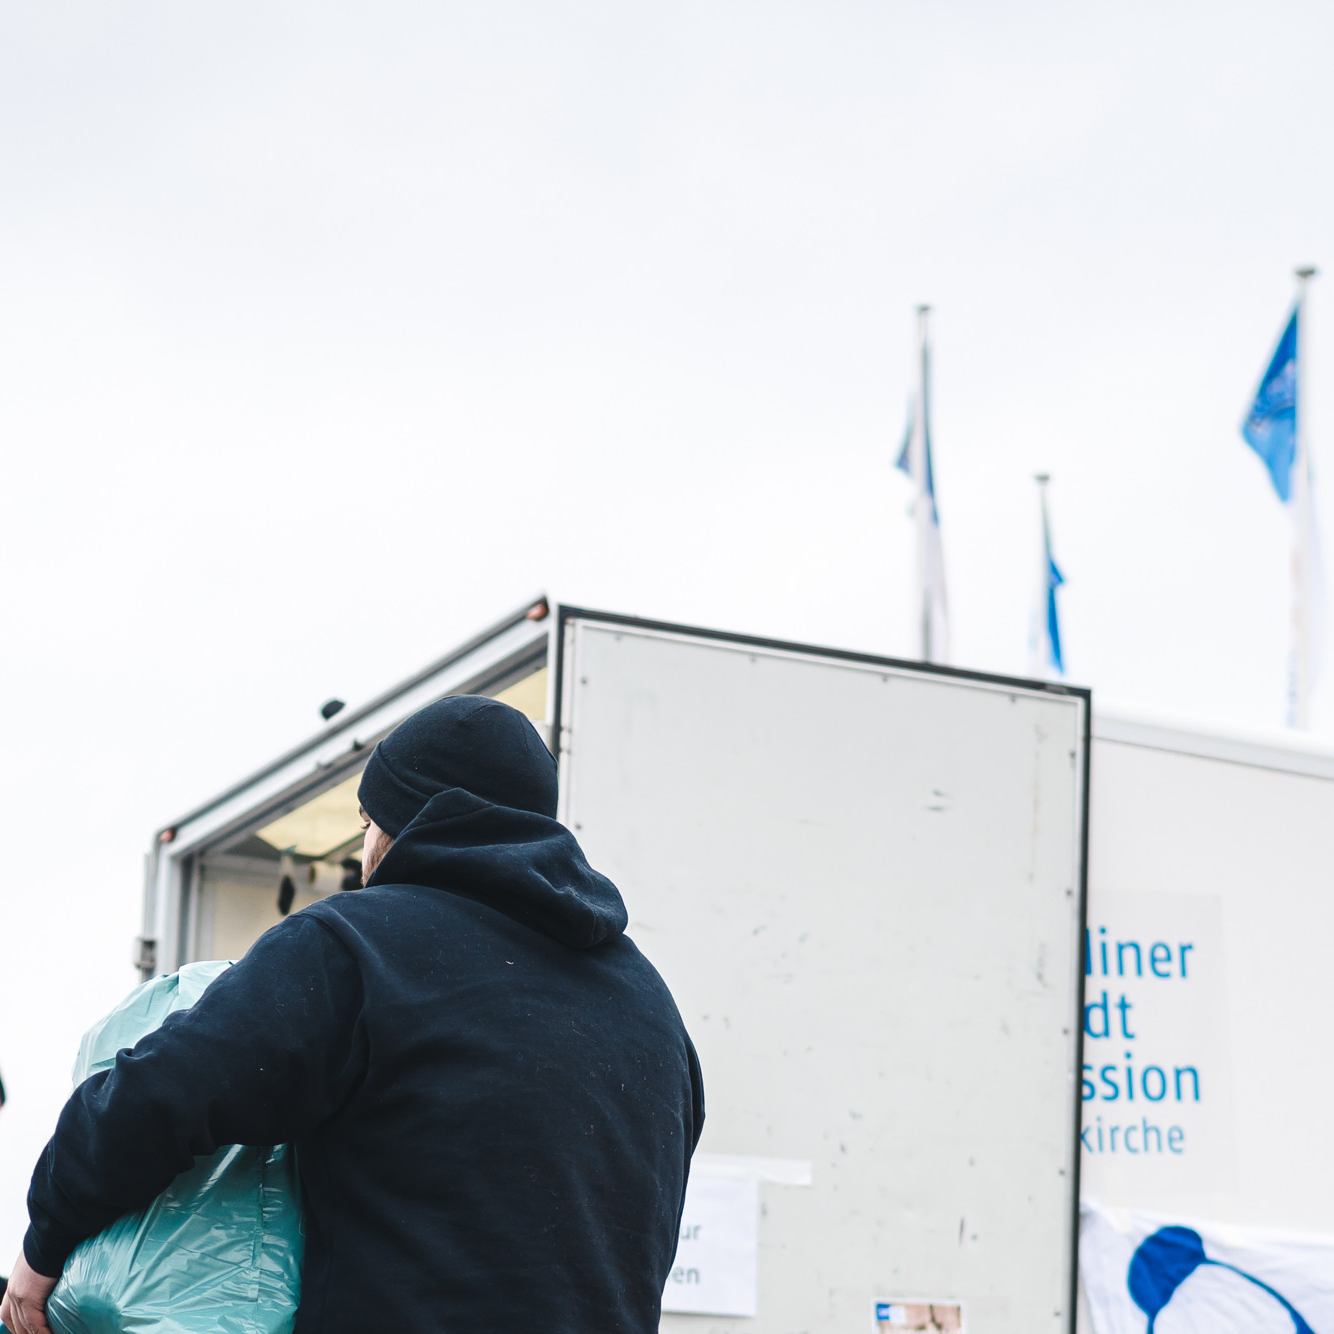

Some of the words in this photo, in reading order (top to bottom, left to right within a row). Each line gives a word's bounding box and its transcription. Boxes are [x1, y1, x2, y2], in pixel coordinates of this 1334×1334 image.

[1085, 926, 1194, 979] liner
[1084, 990, 1136, 1040] dt
[1082, 1051, 1201, 1103] ssion
[1080, 1116, 1185, 1154] kirche
[680, 1223, 702, 1241] ur
[671, 1266, 701, 1285] en
